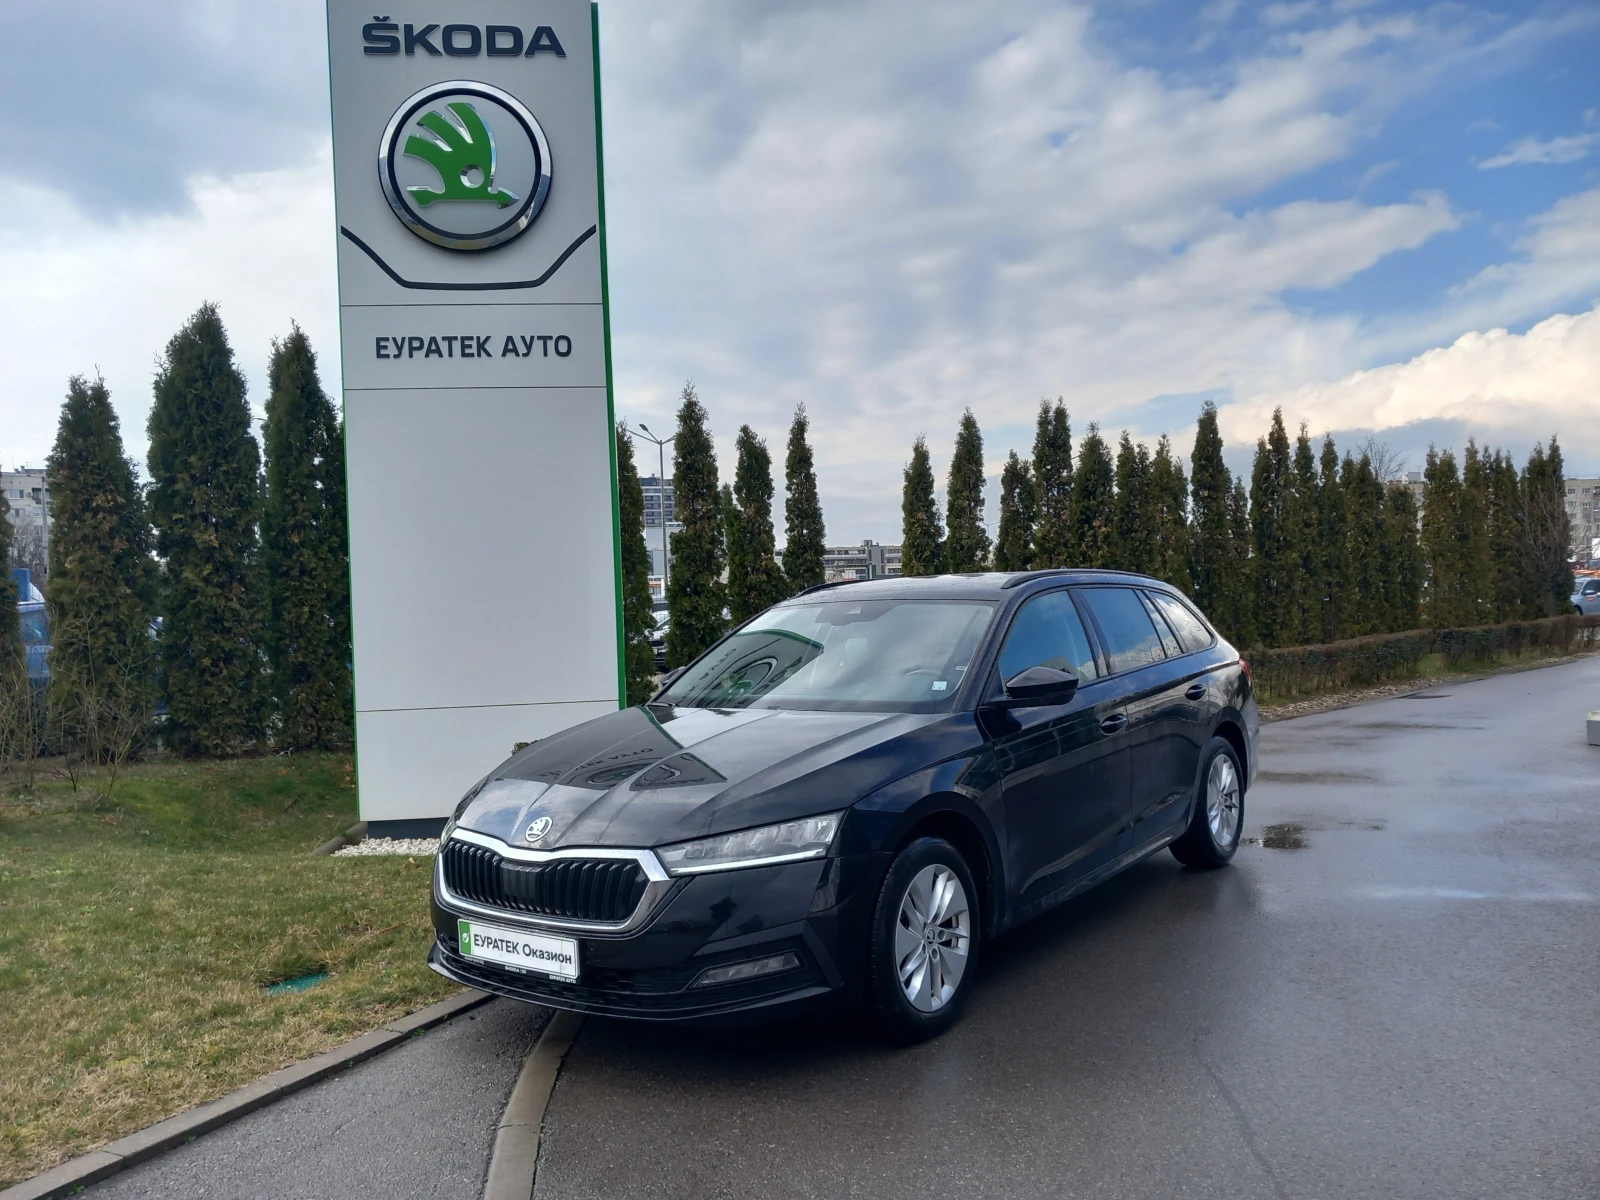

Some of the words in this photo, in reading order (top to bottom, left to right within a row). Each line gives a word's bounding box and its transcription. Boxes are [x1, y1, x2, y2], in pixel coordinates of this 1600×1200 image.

[362, 15, 566, 58] ŠKODA
[375, 335, 493, 360] ЕУРАТЕК
[501, 334, 573, 359] АУТО
[473, 933, 520, 955] ЕУРАТЕК
[522, 943, 572, 965] Оказион
